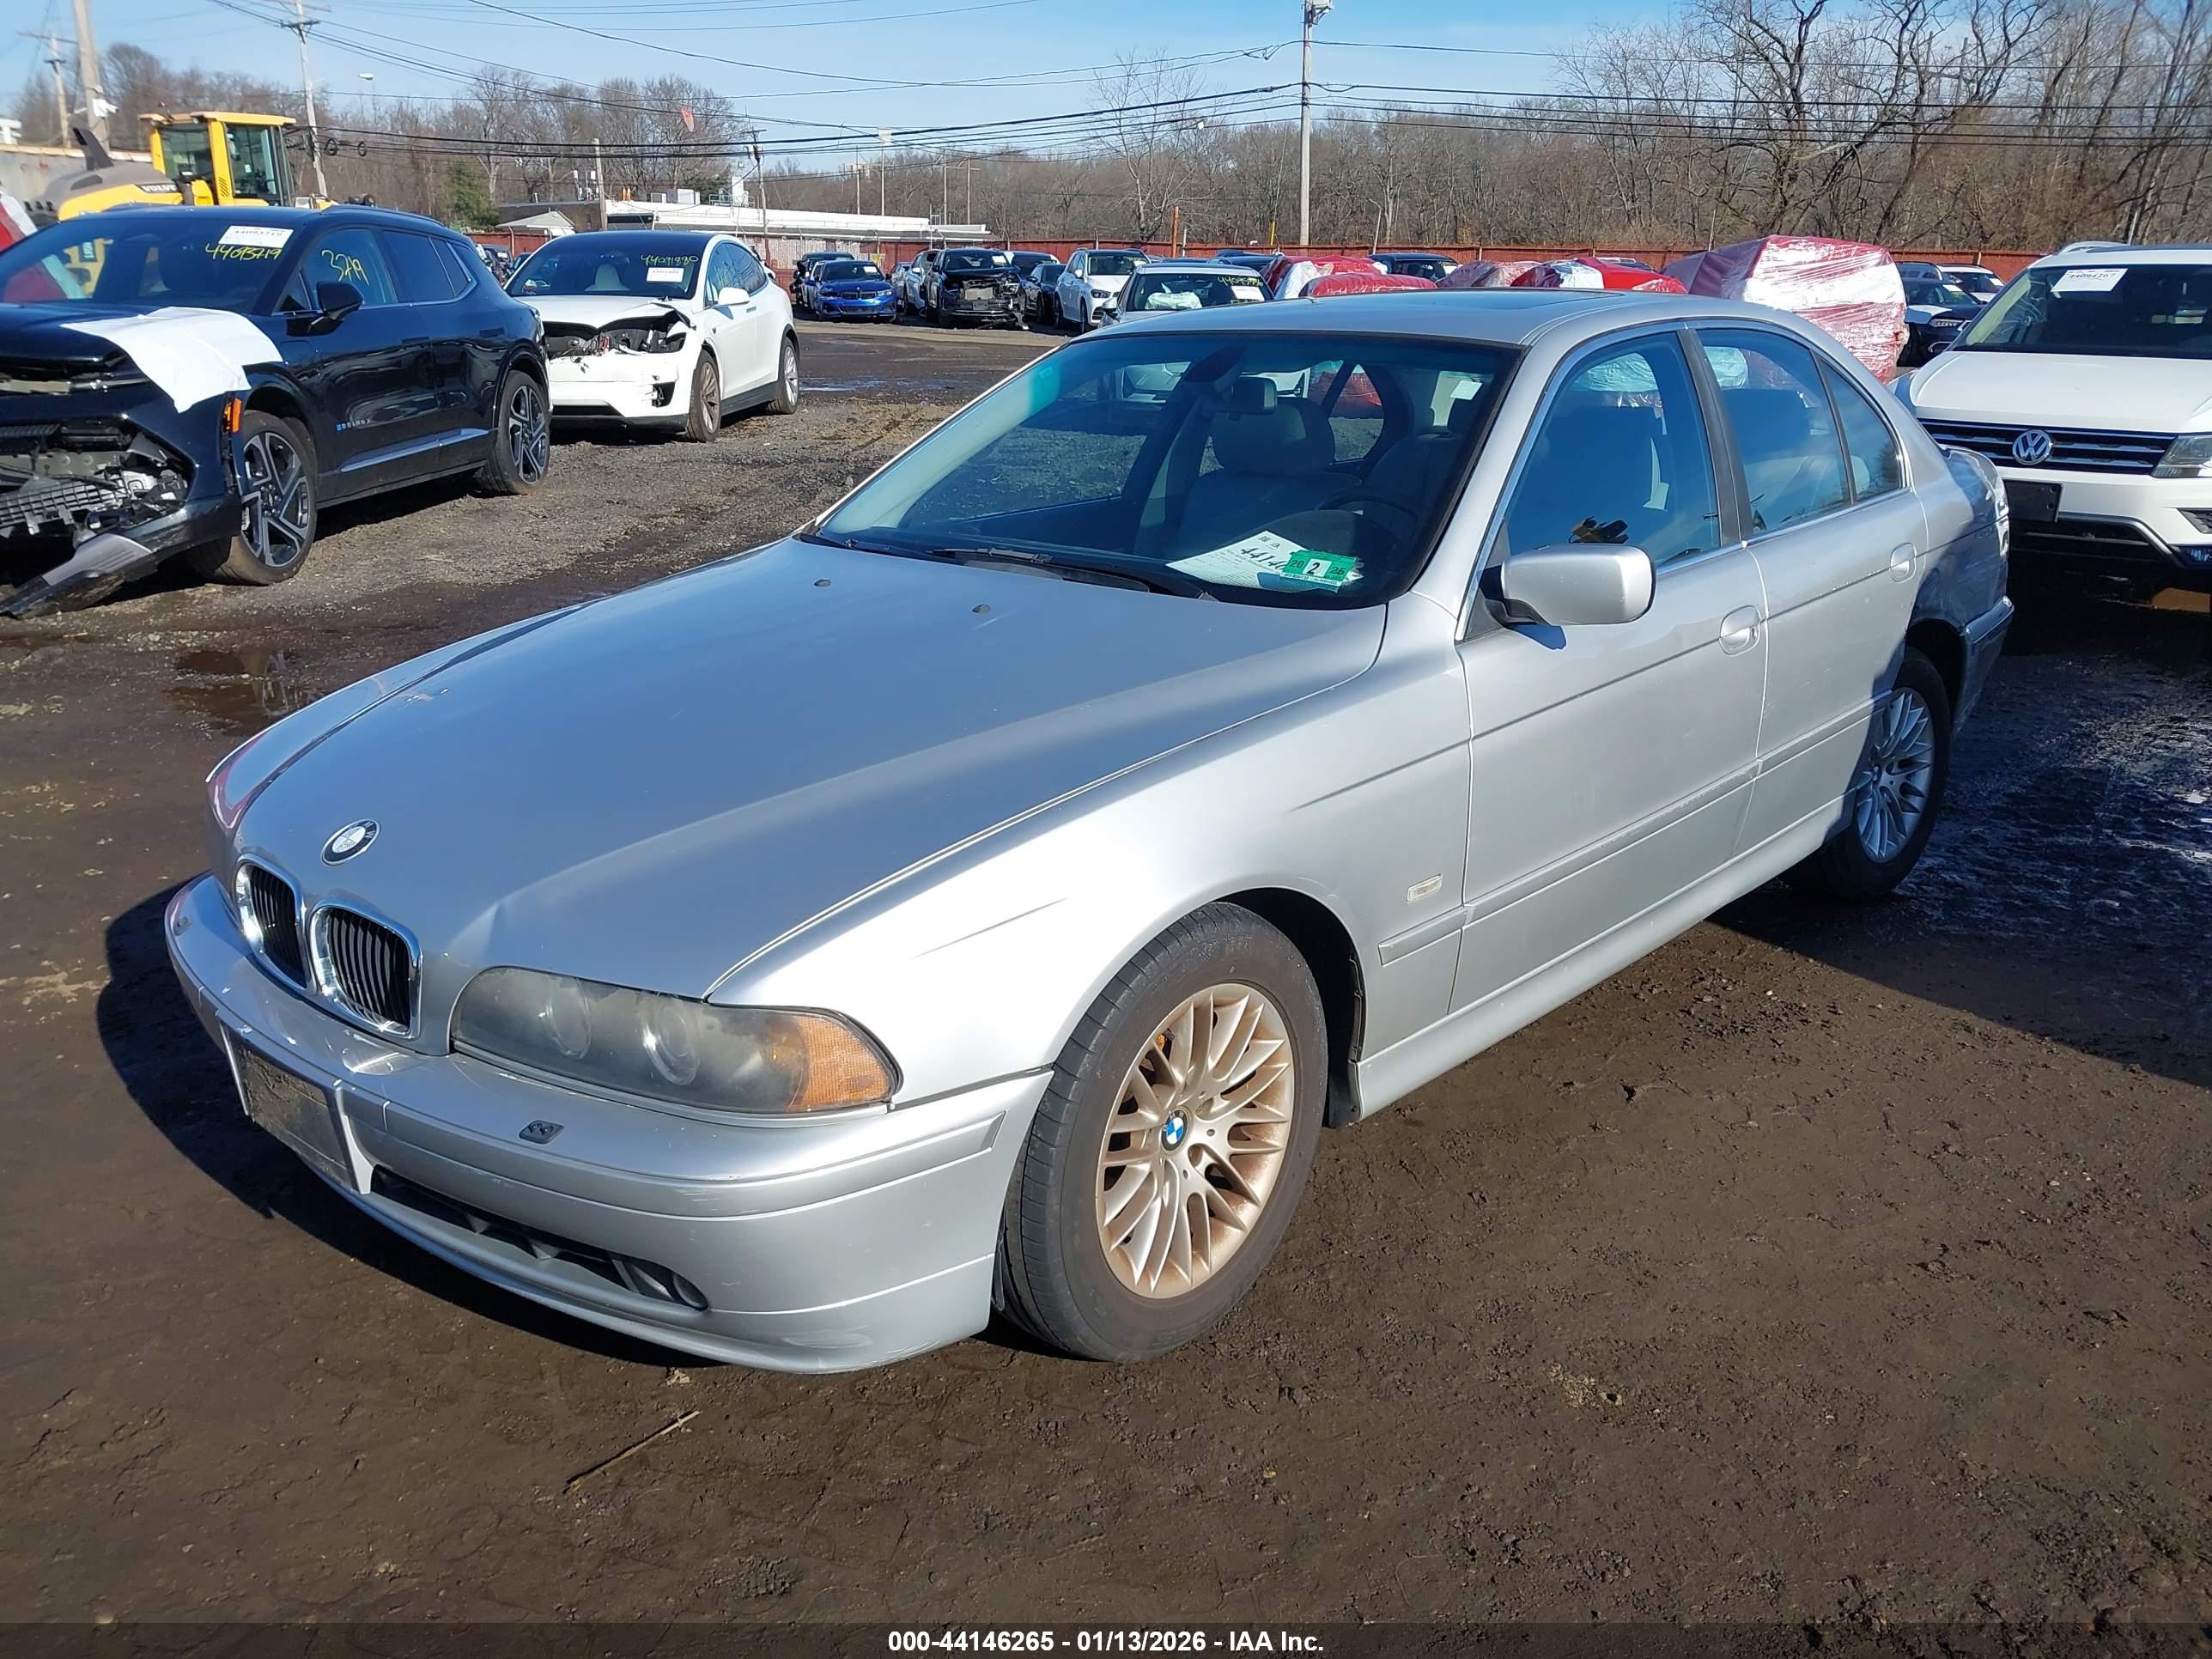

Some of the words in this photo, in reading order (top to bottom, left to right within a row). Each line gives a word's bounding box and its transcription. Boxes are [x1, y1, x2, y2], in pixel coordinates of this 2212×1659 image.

[1290, 559, 1305, 568] 20
[1307, 562, 1321, 575] 2
[1329, 566, 1346, 575] 25
